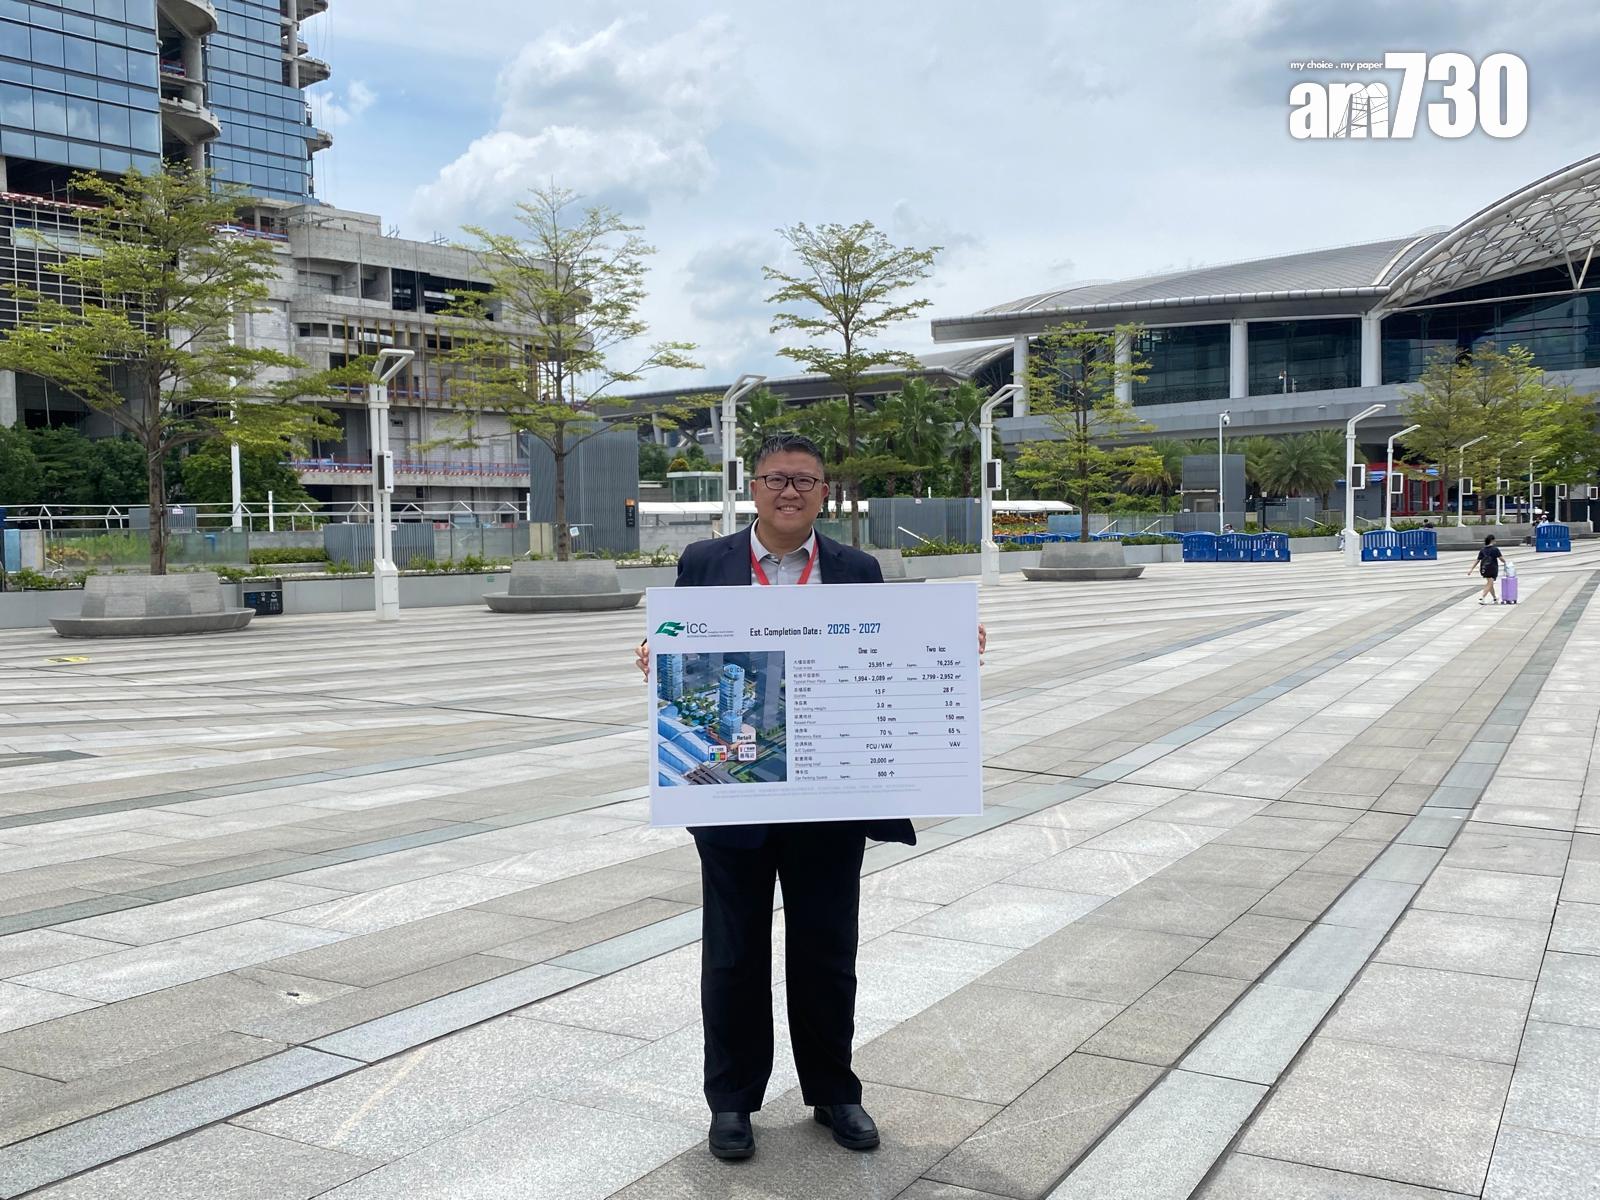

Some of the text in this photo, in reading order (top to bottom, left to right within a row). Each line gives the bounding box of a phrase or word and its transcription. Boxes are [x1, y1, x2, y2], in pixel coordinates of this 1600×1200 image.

[750, 628, 763, 637] Est.
[764, 627, 801, 637] Completion
[827, 624, 850, 634] 2026
[859, 623, 881, 633] 2027
